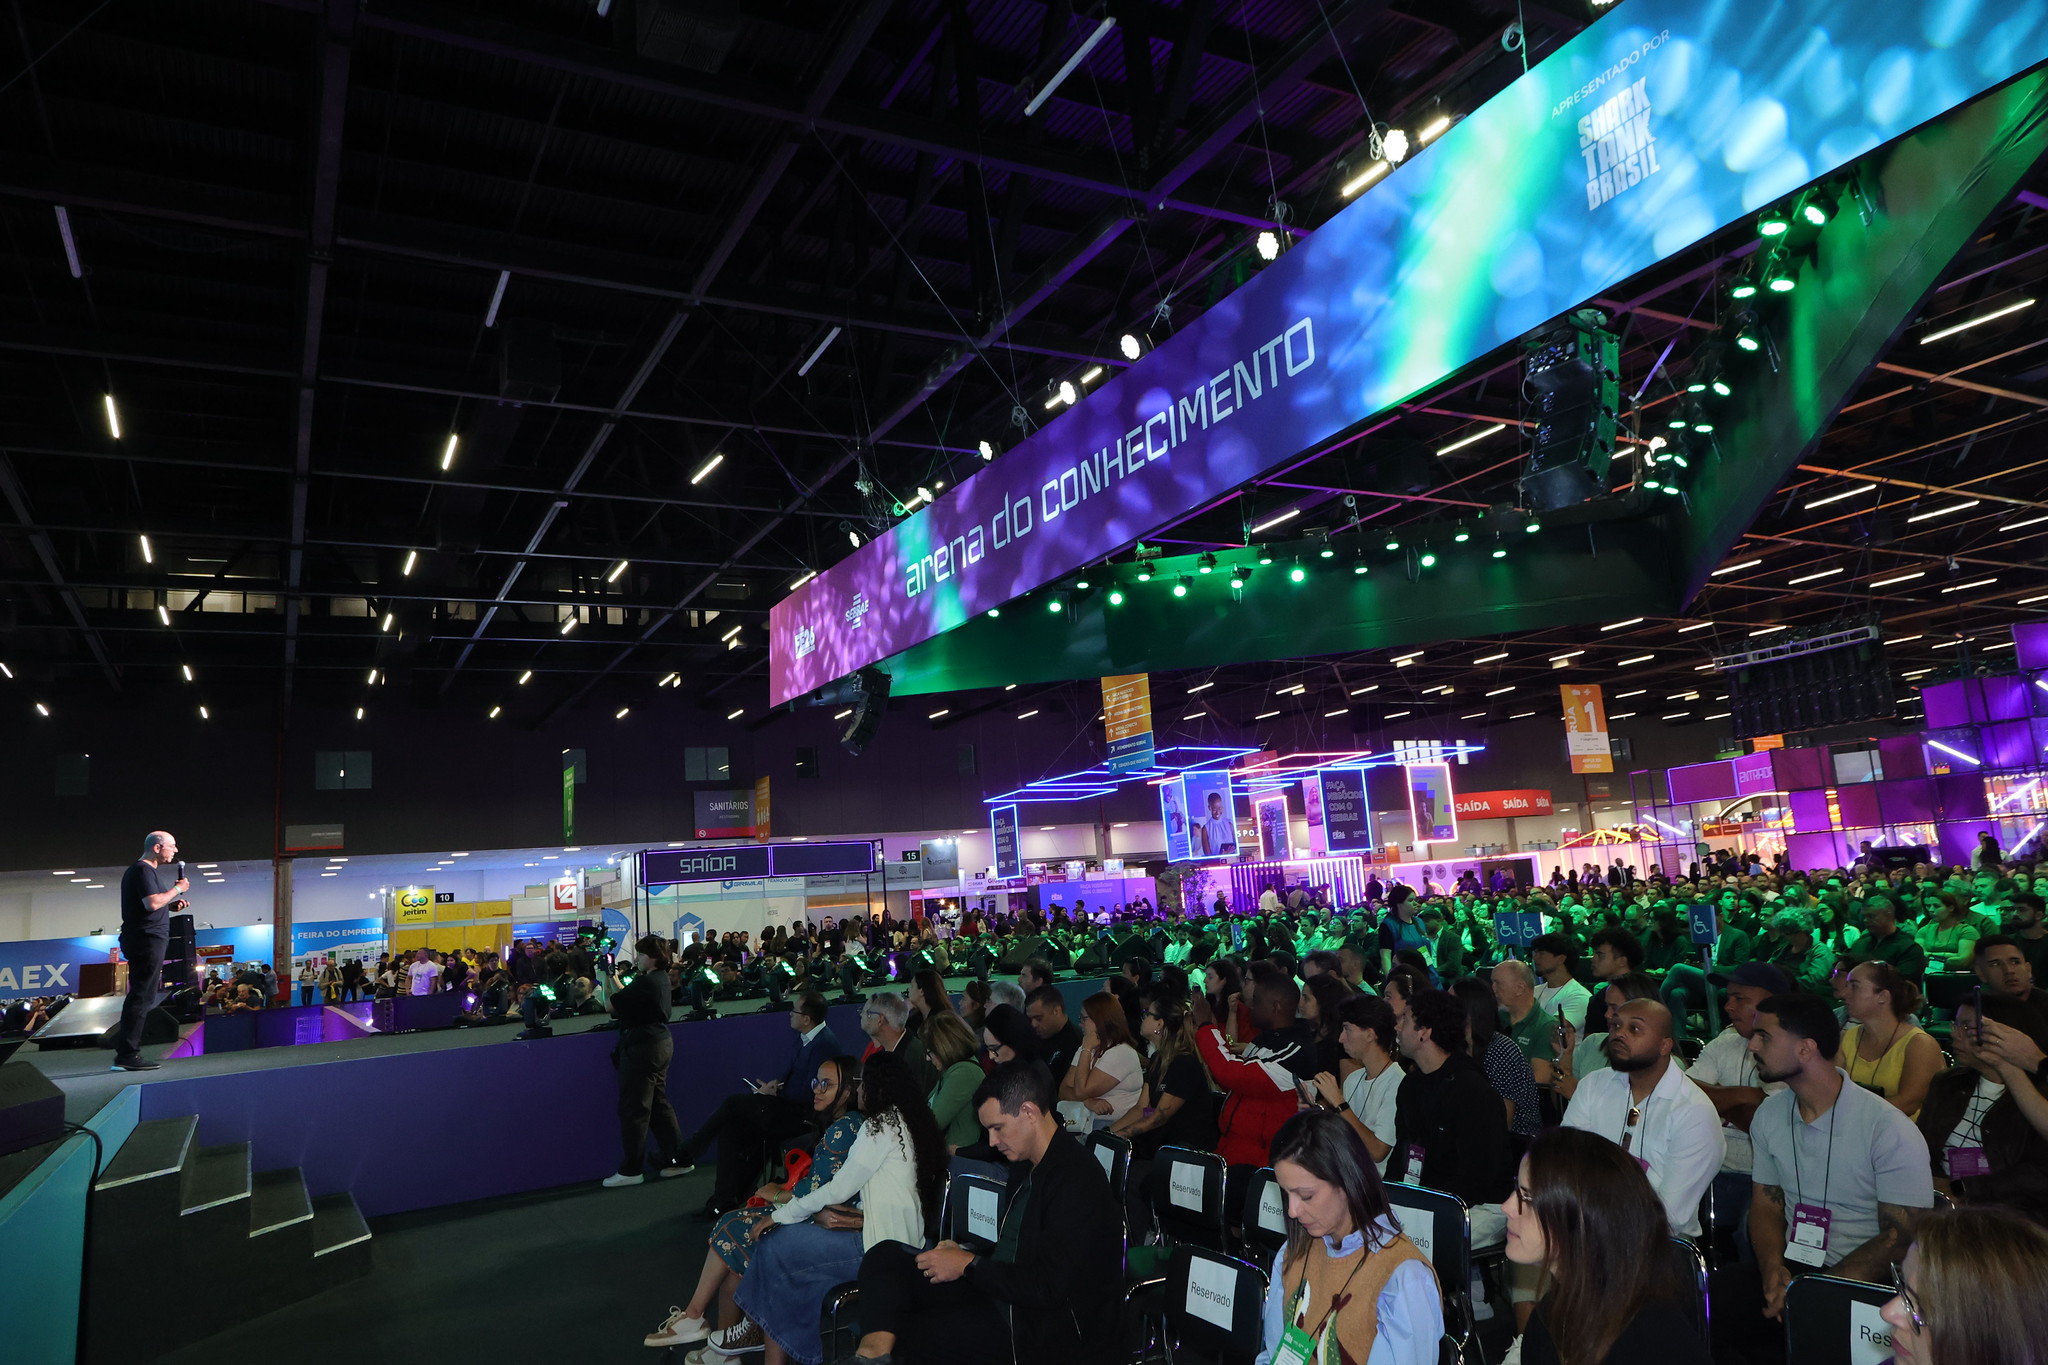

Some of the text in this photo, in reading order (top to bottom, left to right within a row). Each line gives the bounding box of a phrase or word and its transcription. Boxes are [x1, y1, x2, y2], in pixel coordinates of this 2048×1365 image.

[1552, 29, 1671, 120] APRESENTADO POR
[1577, 76, 1651, 149] SHARK
[1581, 107, 1657, 181] TANK
[1586, 144, 1661, 212] BRASIL
[905, 316, 1316, 599] arena do CONHECIMENTO
[845, 600, 869, 622] SEBRAE
[1567, 706, 1578, 733] RUA
[1584, 701, 1597, 733] 1
[1326, 781, 1346, 791] FAÇA
[1327, 790, 1364, 801] NEGÓCIOS
[709, 800, 749, 811] SANITÁRIOS
[1329, 802, 1353, 811] COM O
[1456, 795, 1550, 813] SAÍDA SAÍDA SAÍDA
[1330, 813, 1359, 822] SEBRAE
[680, 853, 737, 874] SAÍDA
[906, 852, 917, 860] 15
[439, 894, 450, 902] 10
[297, 927, 383, 940] FEIRA DO EMPREEN
[1172, 1181, 1201, 1197] Reservado
[970, 1208, 996, 1227] Reservado
[1191, 1281, 1231, 1308] Reservado
[1860, 1324, 1893, 1348] Res
